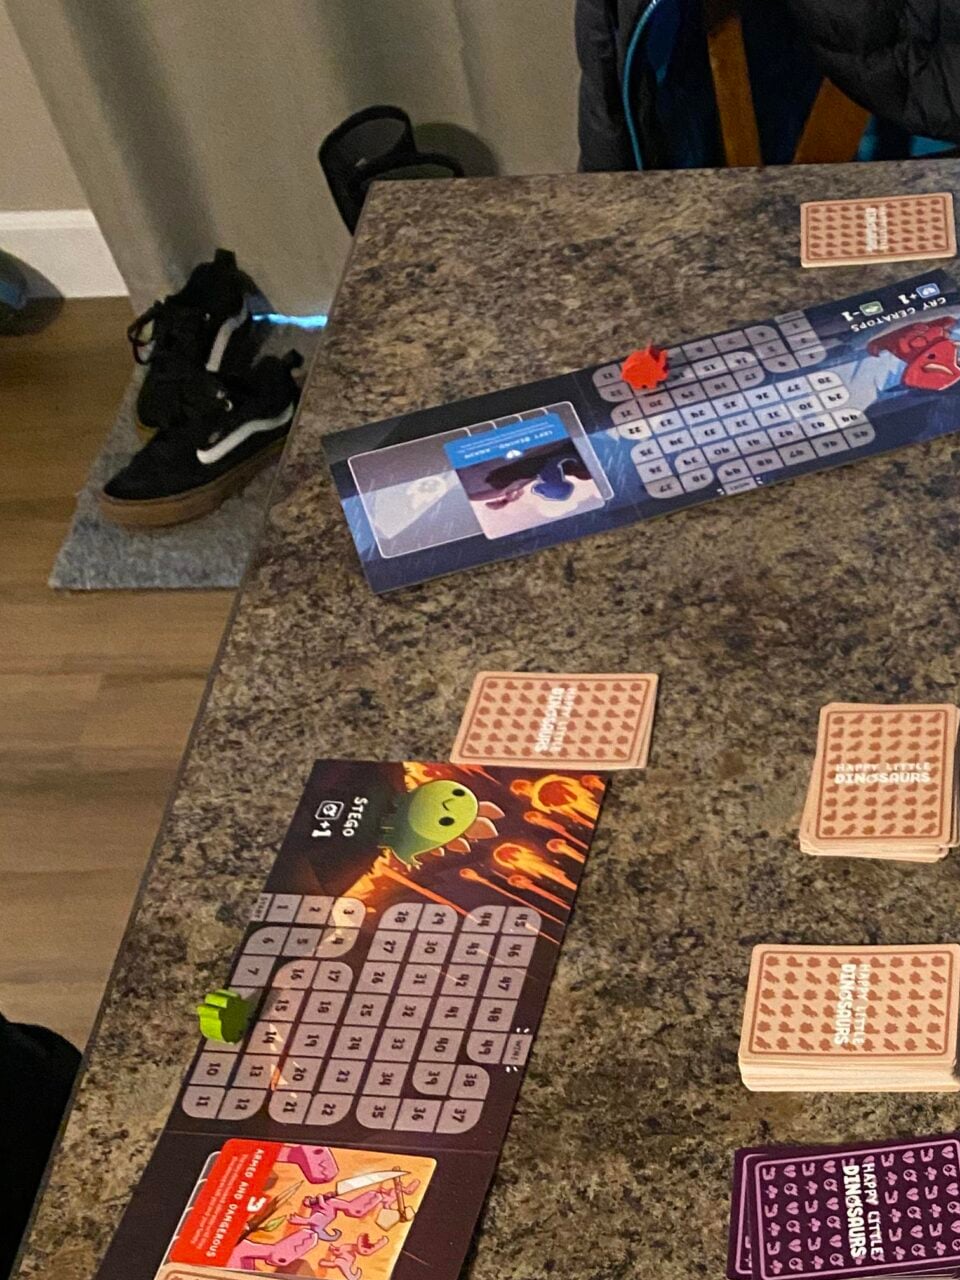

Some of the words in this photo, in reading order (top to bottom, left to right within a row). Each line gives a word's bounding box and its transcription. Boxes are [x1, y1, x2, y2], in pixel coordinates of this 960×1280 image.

[923, 295, 946, 312] CRY
[850, 305, 918, 333] CERATOPS
[835, 762, 878, 772] HAPPY
[885, 762, 930, 772] LITTLE
[834, 771, 930, 784] DINOSAURS
[342, 796, 369, 837] STEGO
[311, 820, 332, 839] +1
[478, 912, 492, 926] 44
[514, 914, 528, 927] 45
[466, 942, 480, 955] 43
[508, 944, 522, 957] 46
[456, 974, 469, 987] 42
[498, 977, 511, 991] 47
[860, 964, 870, 998] HAPPY
[833, 963, 857, 1046] DINOSAURS
[444, 1006, 459, 1018] 41
[488, 1008, 502, 1022] 48
[853, 1003, 866, 1045] LITTLE
[434, 1038, 448, 1052] 40
[478, 1040, 493, 1055] 49
[425, 1072, 440, 1085] 39
[464, 1074, 477, 1086] 38
[412, 1108, 426, 1120] 36
[452, 1109, 466, 1122] 37
[243, 1148, 264, 1179] ARMED
[232, 1181, 251, 1199] AND
[862, 1162, 880, 1205] HAPPY
[843, 1165, 867, 1259] DINOSAURS
[206, 1204, 238, 1258] DANGEROUS
[867, 1211, 885, 1260] LITTLE
